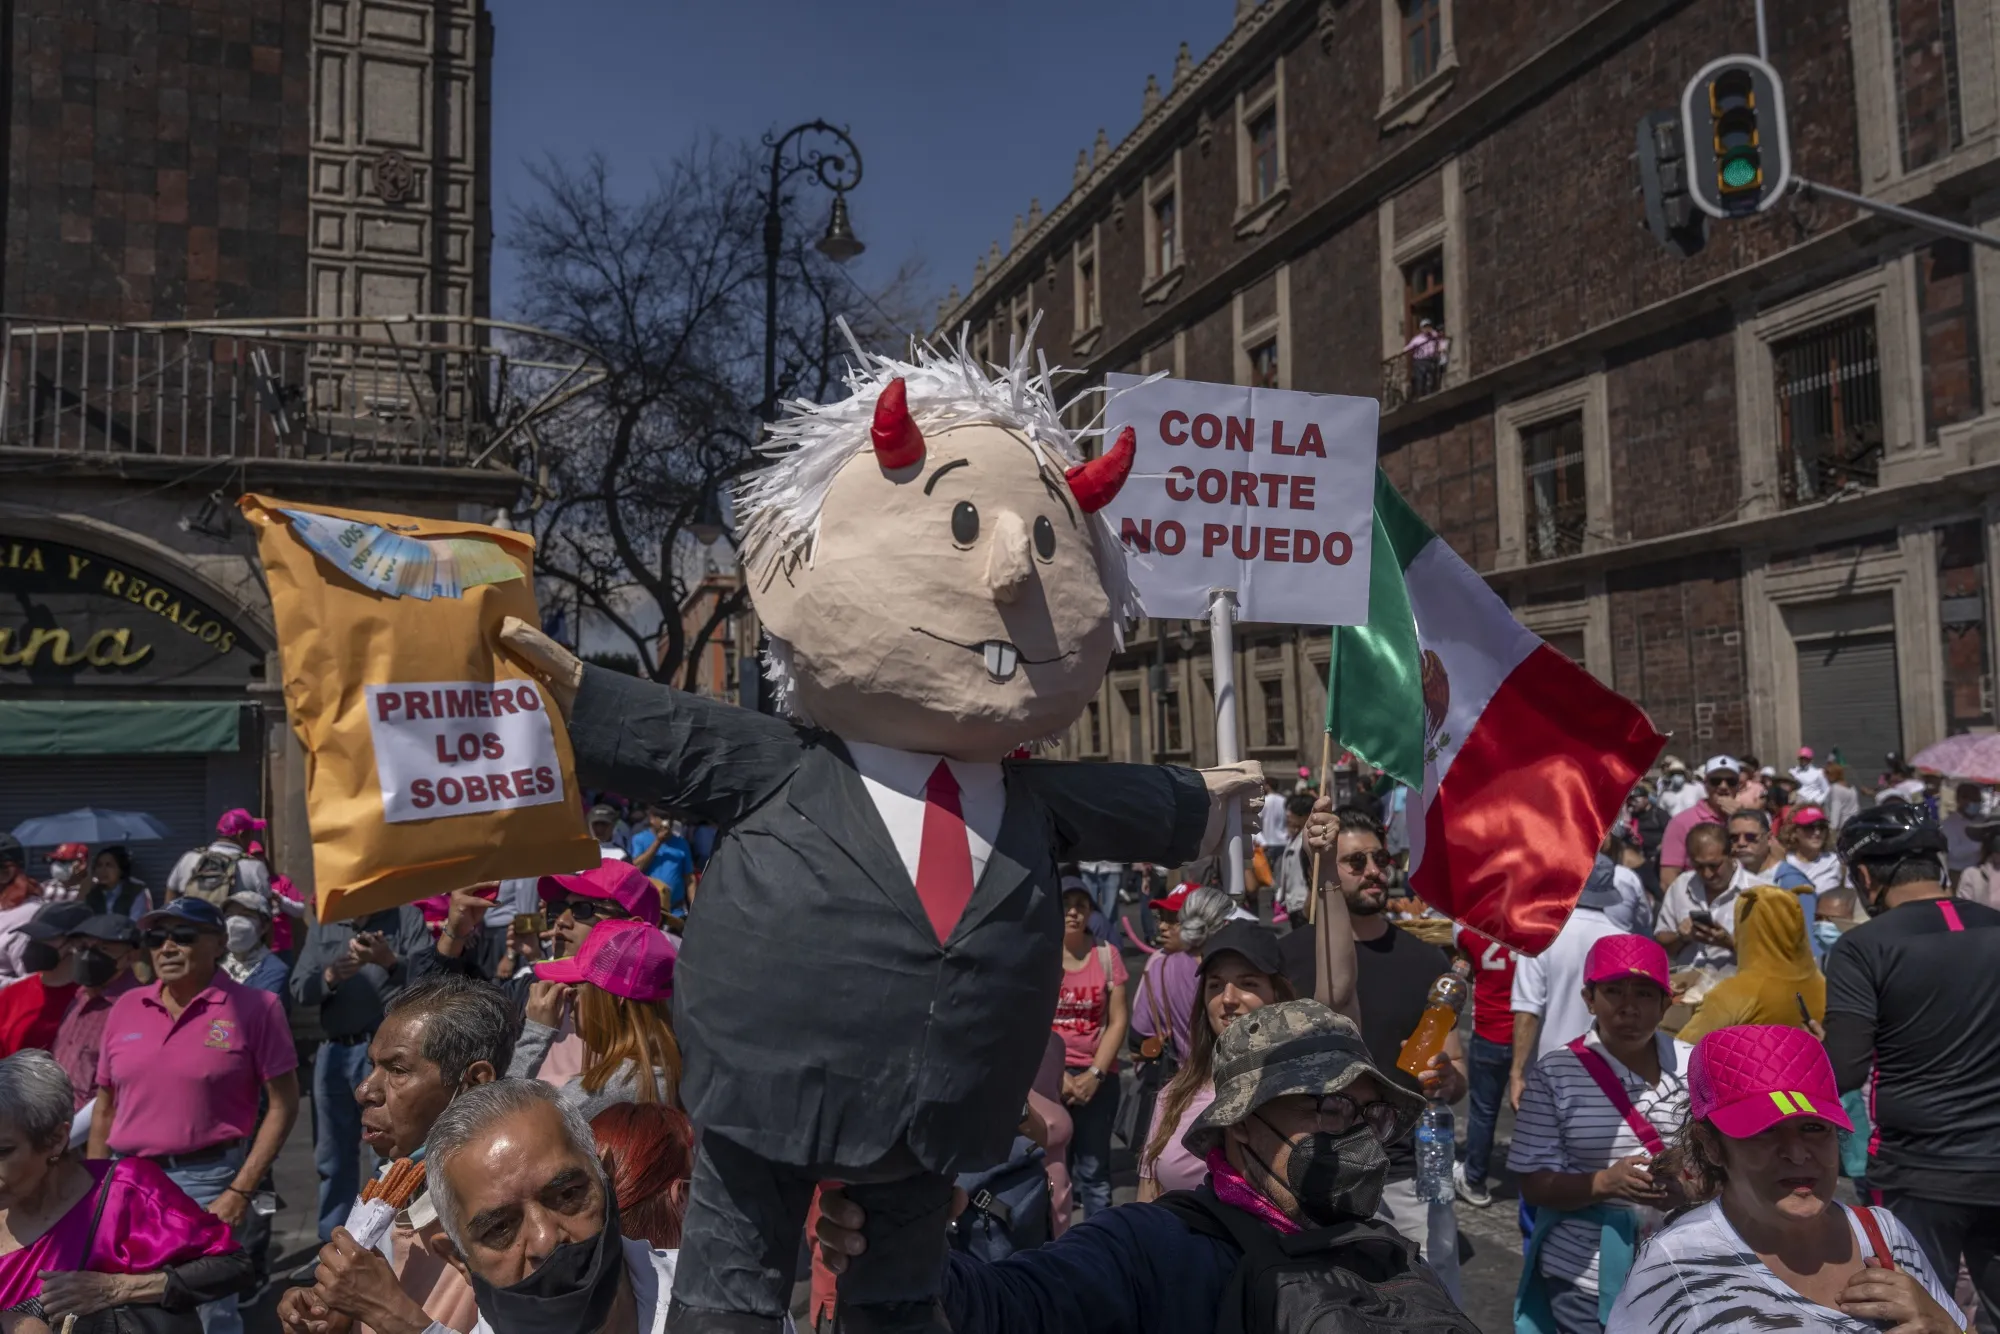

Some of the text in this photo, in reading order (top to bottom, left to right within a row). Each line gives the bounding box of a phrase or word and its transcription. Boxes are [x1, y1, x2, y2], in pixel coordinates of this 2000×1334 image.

[1159, 410, 1327, 458] CON LA
[1165, 465, 1316, 511] CORTE
[1120, 517, 1353, 566] NO PUEDO
[0, 543, 237, 653] IA Y REGALOS
[376, 685, 540, 722] PRIMERO
[435, 732, 504, 763] LOS
[410, 766, 556, 809] SOBRES
